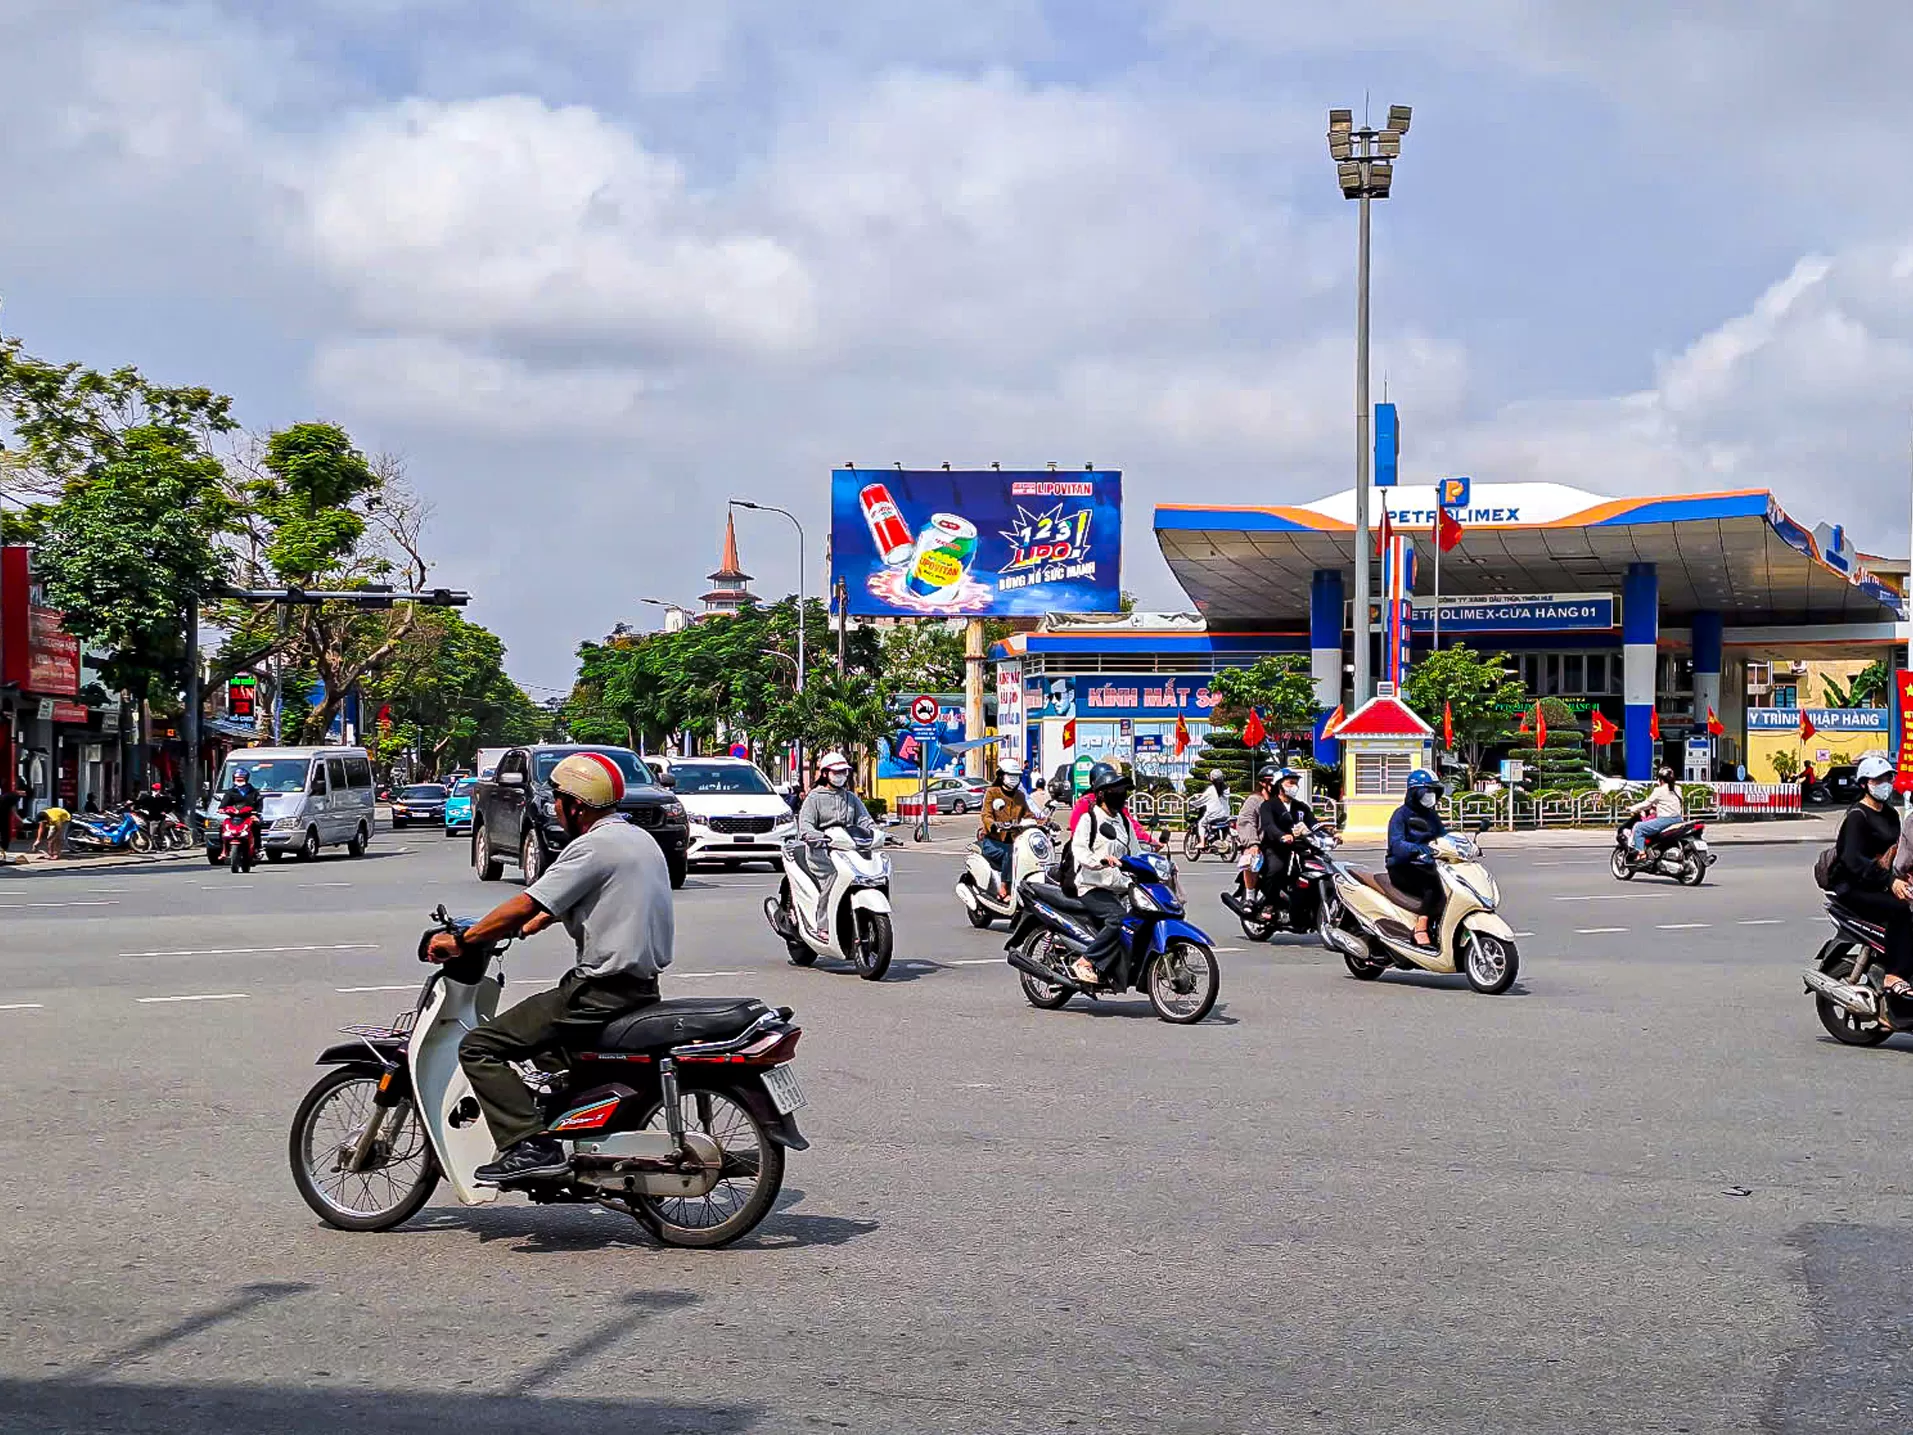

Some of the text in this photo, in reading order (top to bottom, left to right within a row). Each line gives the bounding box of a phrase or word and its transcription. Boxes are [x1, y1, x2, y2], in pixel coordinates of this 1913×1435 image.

[1037, 483, 1092, 495] LIPOVITAN
[1412, 605, 1596, 620] ETROLIMEX-CỬA HÀNG 01
[1088, 682, 1138, 707] KÍNH
[1143, 678, 1190, 707] MẮT
[1762, 710, 1800, 725] TRÌNH
[1842, 711, 1880, 725] HÀNG
